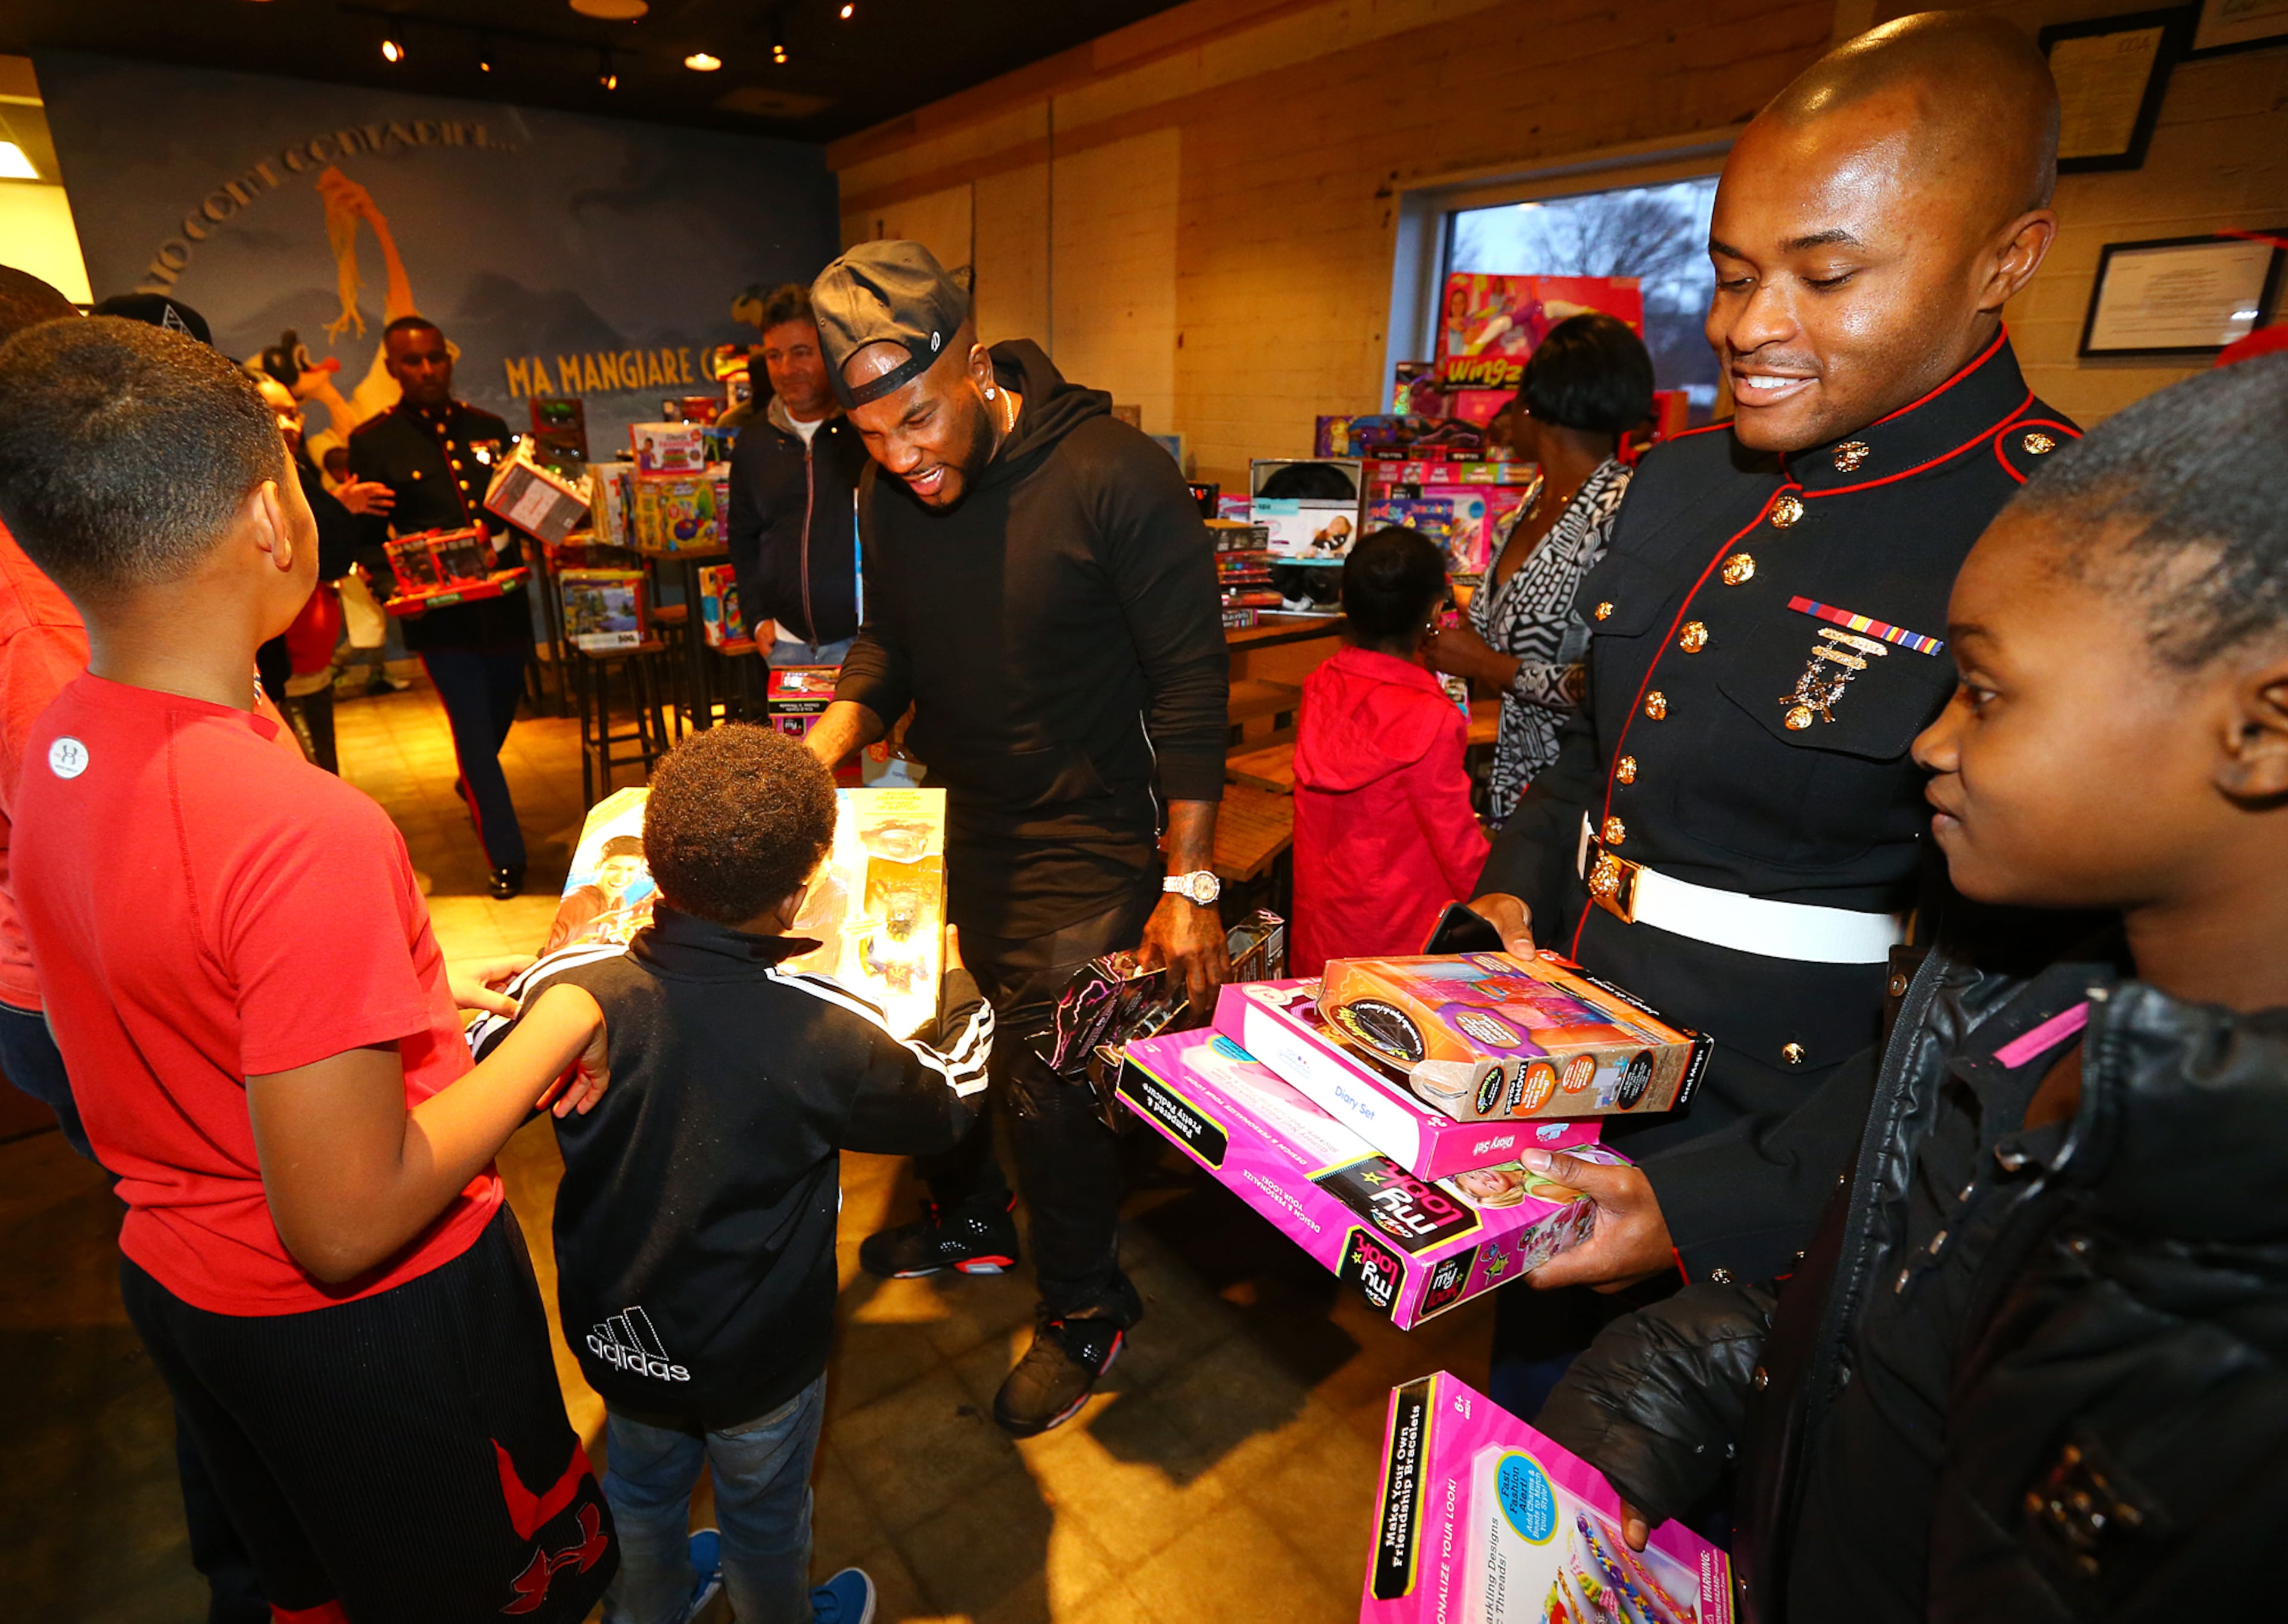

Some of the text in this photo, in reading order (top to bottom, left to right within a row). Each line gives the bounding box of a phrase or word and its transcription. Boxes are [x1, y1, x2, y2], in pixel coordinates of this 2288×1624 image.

[505, 347, 717, 398] MA MANGIARE C
[1143, 1083, 1202, 1134] Pretty Pedicure
[1148, 1096, 1193, 1138] Pampered &
[1205, 1091, 1224, 1105] YOUR
[1335, 1085, 1376, 1121] Diary Set
[1224, 1105, 1271, 1138] PERSONALIZE
[1277, 1144, 1307, 1164] DESIGN
[1473, 1135, 1515, 1156] Diary Set
[1244, 1169, 1286, 1206] PERSONALIZE
[1262, 1176, 1302, 1211] YOUR LOOK!
[1377, 1156, 1462, 1228] look
[1294, 1209, 1320, 1233] DESIGN
[1370, 1186, 1438, 1236] my
[1354, 1232, 1399, 1283] look
[1433, 1265, 1459, 1290] my
[1360, 1262, 1393, 1301] my
[586, 1334, 691, 1381] adidas
[1455, 1395, 1465, 1413] 6+
[1385, 1426, 1410, 1548] Make Your Own
[1392, 1405, 1420, 1567] Friendship Bracelets
[1446, 1479, 1457, 1519] LOOK!
[1502, 1471, 1510, 1498] Fast
[1510, 1467, 1519, 1514] Fashion
[1519, 1478, 1528, 1513] Alert!
[1527, 1478, 1535, 1511] Charms
[1442, 1519, 1454, 1559] YOUR
[1488, 1517, 1499, 1572] Designs
[1496, 1553, 1507, 1615] Threads!
[1701, 1550, 1713, 1603] WARNING:
